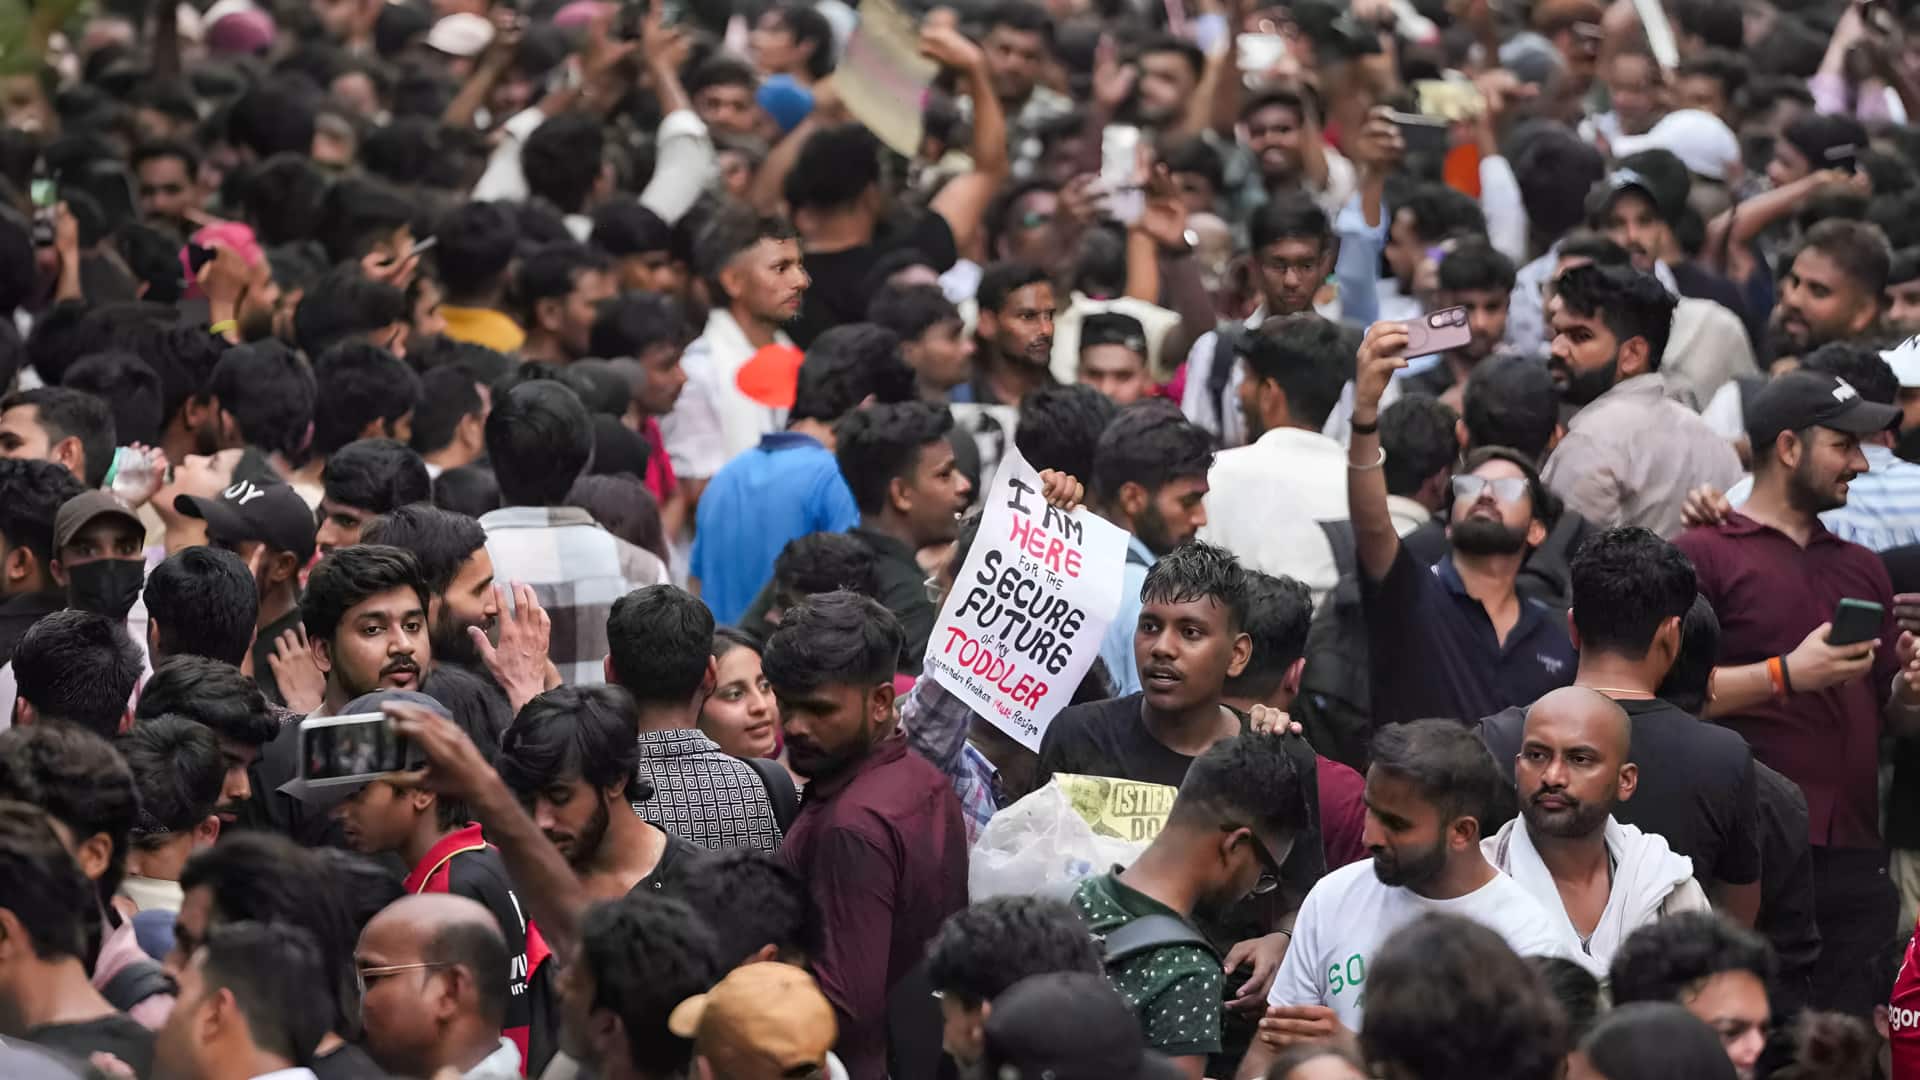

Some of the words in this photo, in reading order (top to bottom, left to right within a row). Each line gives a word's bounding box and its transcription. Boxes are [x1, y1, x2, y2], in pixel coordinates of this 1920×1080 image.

[1007, 478, 1036, 516] I
[1042, 503, 1083, 546] AM
[1009, 513, 1083, 578] HERE
[976, 549, 1086, 640] SECURE
[1019, 554, 1039, 578] FOR
[1044, 569, 1065, 591] THE
[955, 587, 1073, 676] FUTURE
[944, 626, 1048, 711] TODDLER
[1012, 710, 1039, 737] Resign
